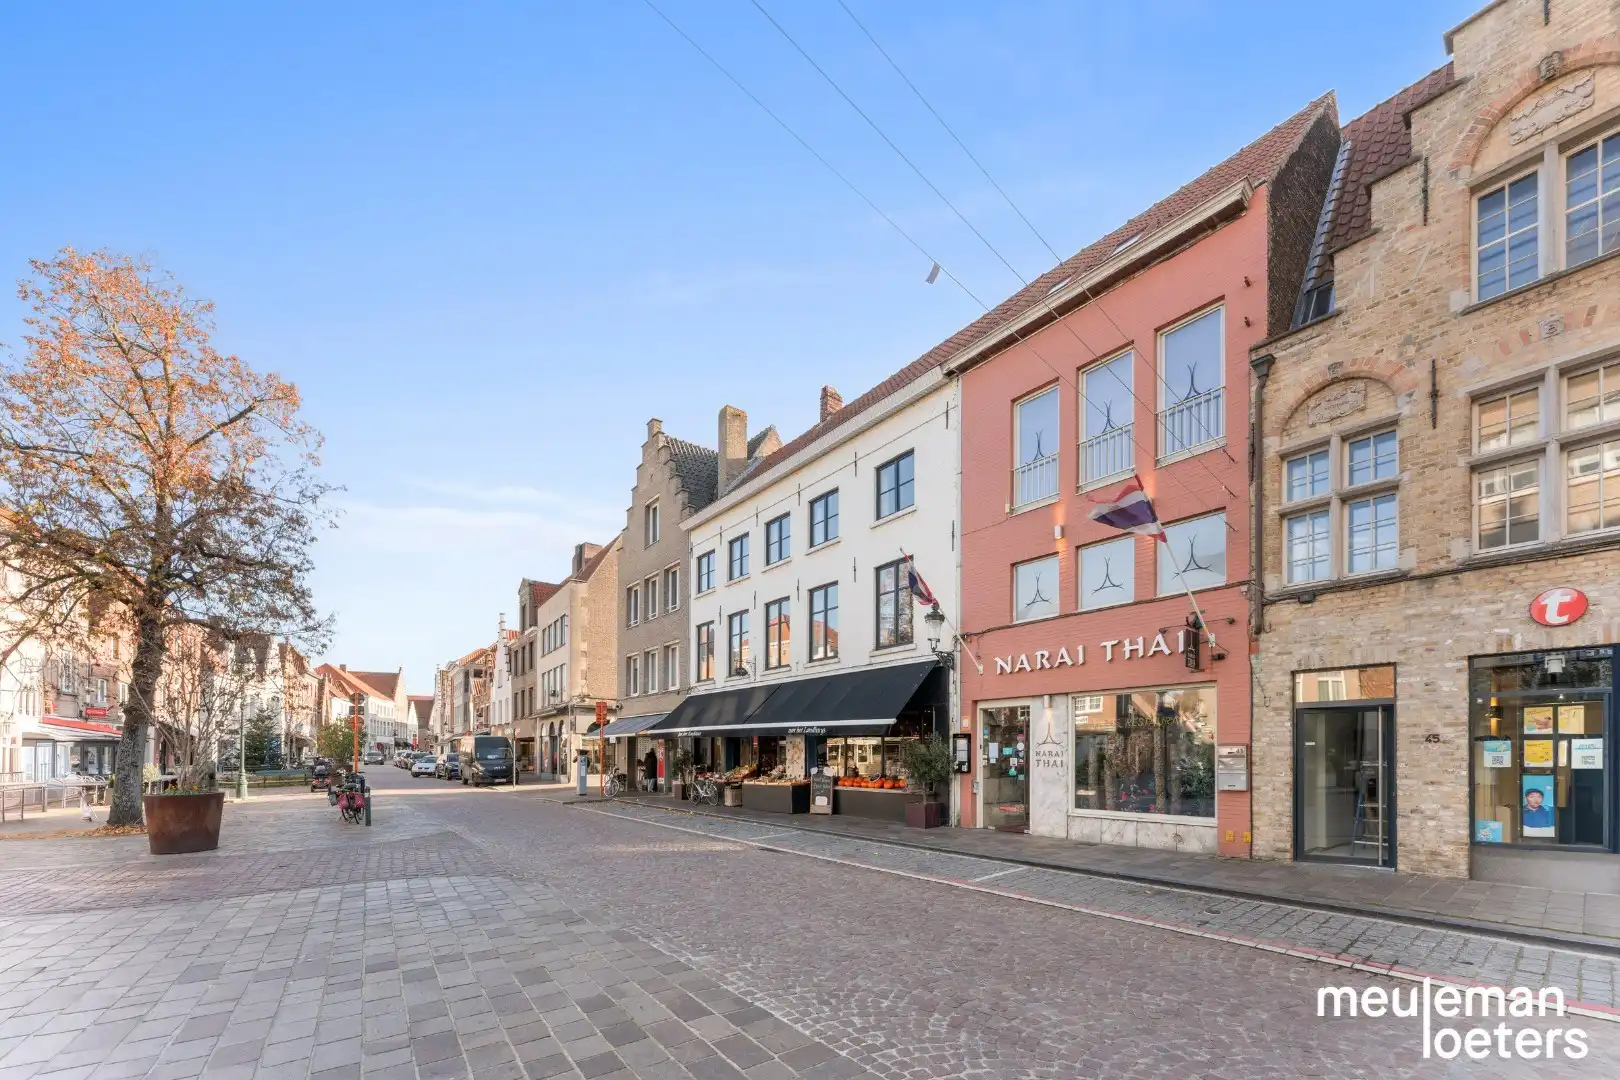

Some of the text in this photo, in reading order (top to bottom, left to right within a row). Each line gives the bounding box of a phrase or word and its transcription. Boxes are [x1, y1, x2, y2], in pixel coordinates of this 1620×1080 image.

[994, 644, 1085, 675] NARAI
[1100, 630, 1185, 662] THAI
[1425, 734, 1440, 744] 45
[1035, 759, 1064, 768] THAI
